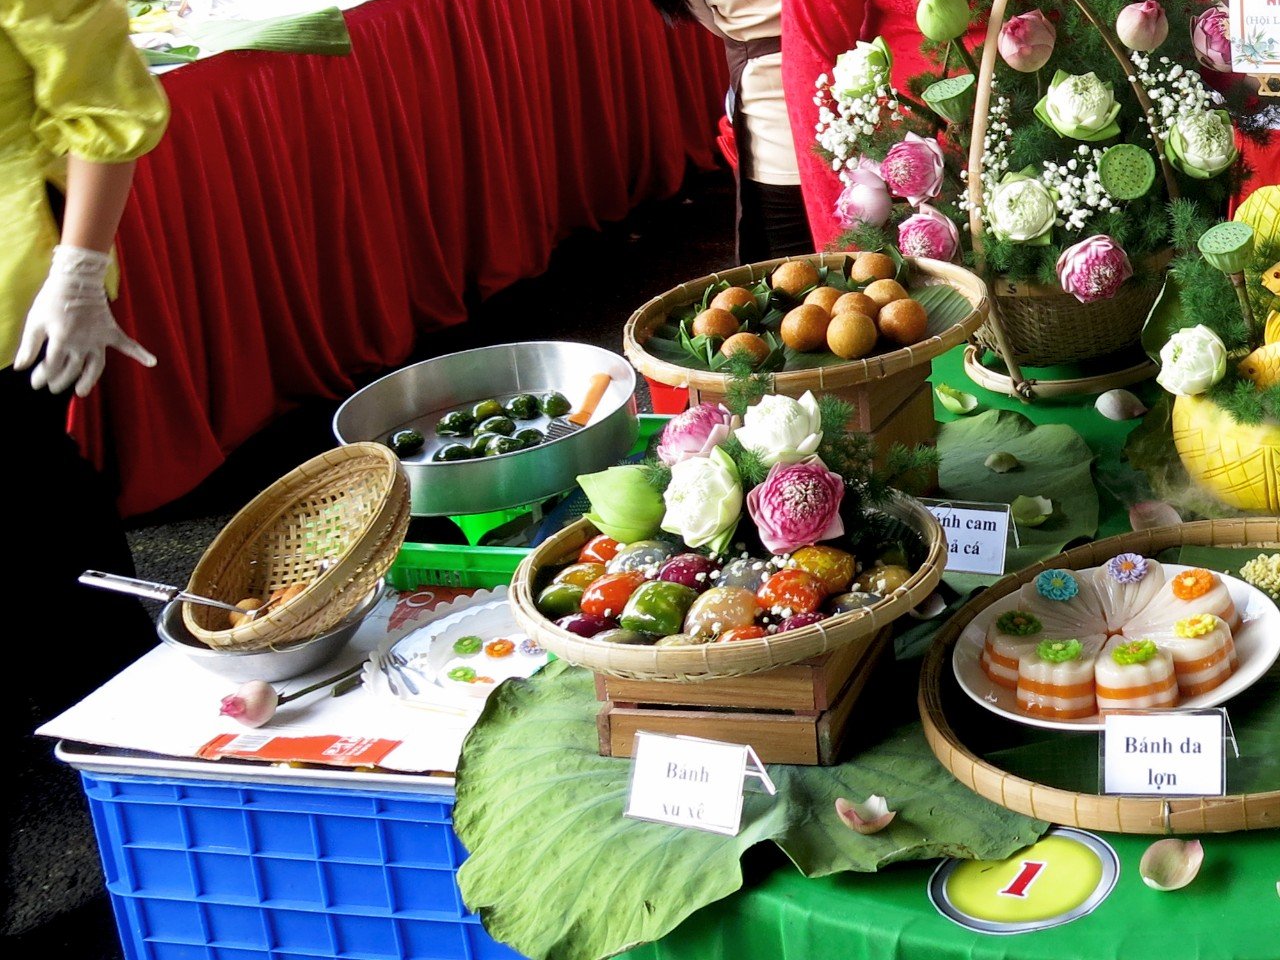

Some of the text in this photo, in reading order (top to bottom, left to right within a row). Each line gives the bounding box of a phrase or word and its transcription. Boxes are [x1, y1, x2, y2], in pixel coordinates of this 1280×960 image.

[966, 519, 997, 532] cam
[963, 541, 980, 555] cá
[1124, 736, 1202, 754] Bánh da
[665, 762, 710, 783] Bánh
[1147, 768, 1177, 790] lợn
[1000, 861, 1044, 897] 1
